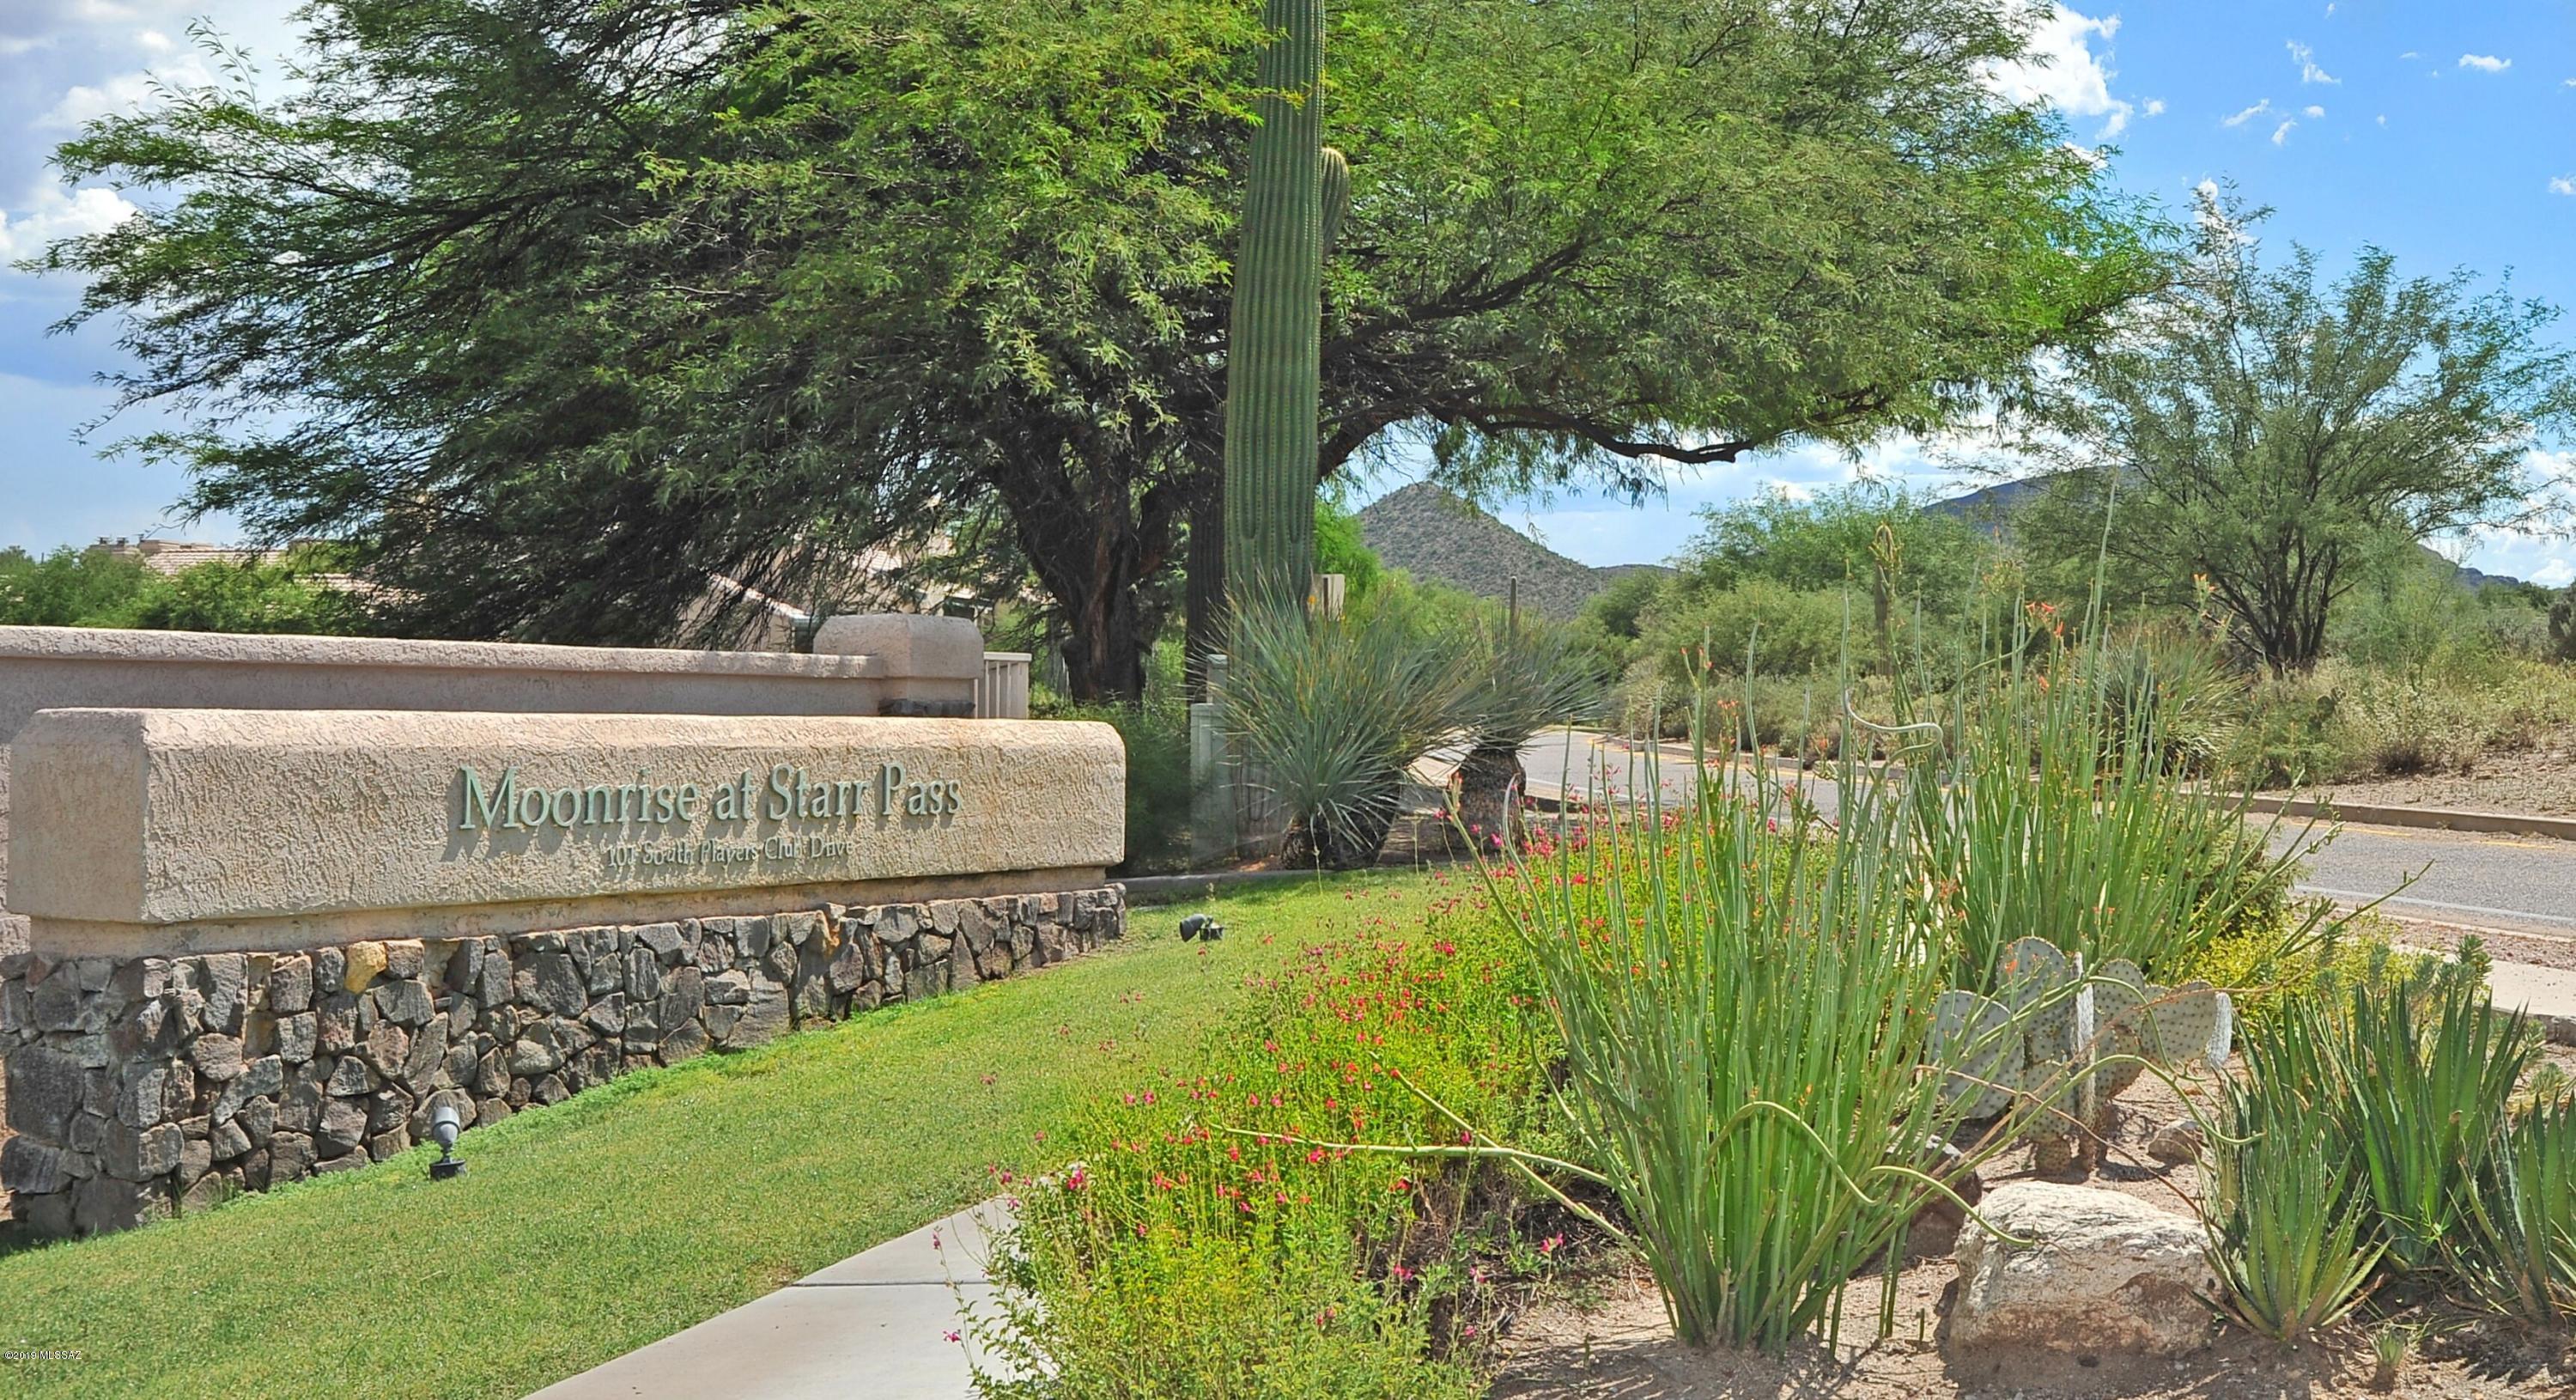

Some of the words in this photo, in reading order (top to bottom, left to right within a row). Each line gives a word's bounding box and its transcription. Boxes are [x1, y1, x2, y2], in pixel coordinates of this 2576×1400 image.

[459, 763, 702, 830] Moonrise
[714, 767, 757, 820] at
[769, 763, 877, 820] Starr
[882, 761, 963, 816] Pass
[608, 843, 637, 867] 101
[642, 838, 695, 866] South
[700, 838, 758, 868] Players
[763, 836, 804, 861] Club
[810, 835, 855, 859] Drive
